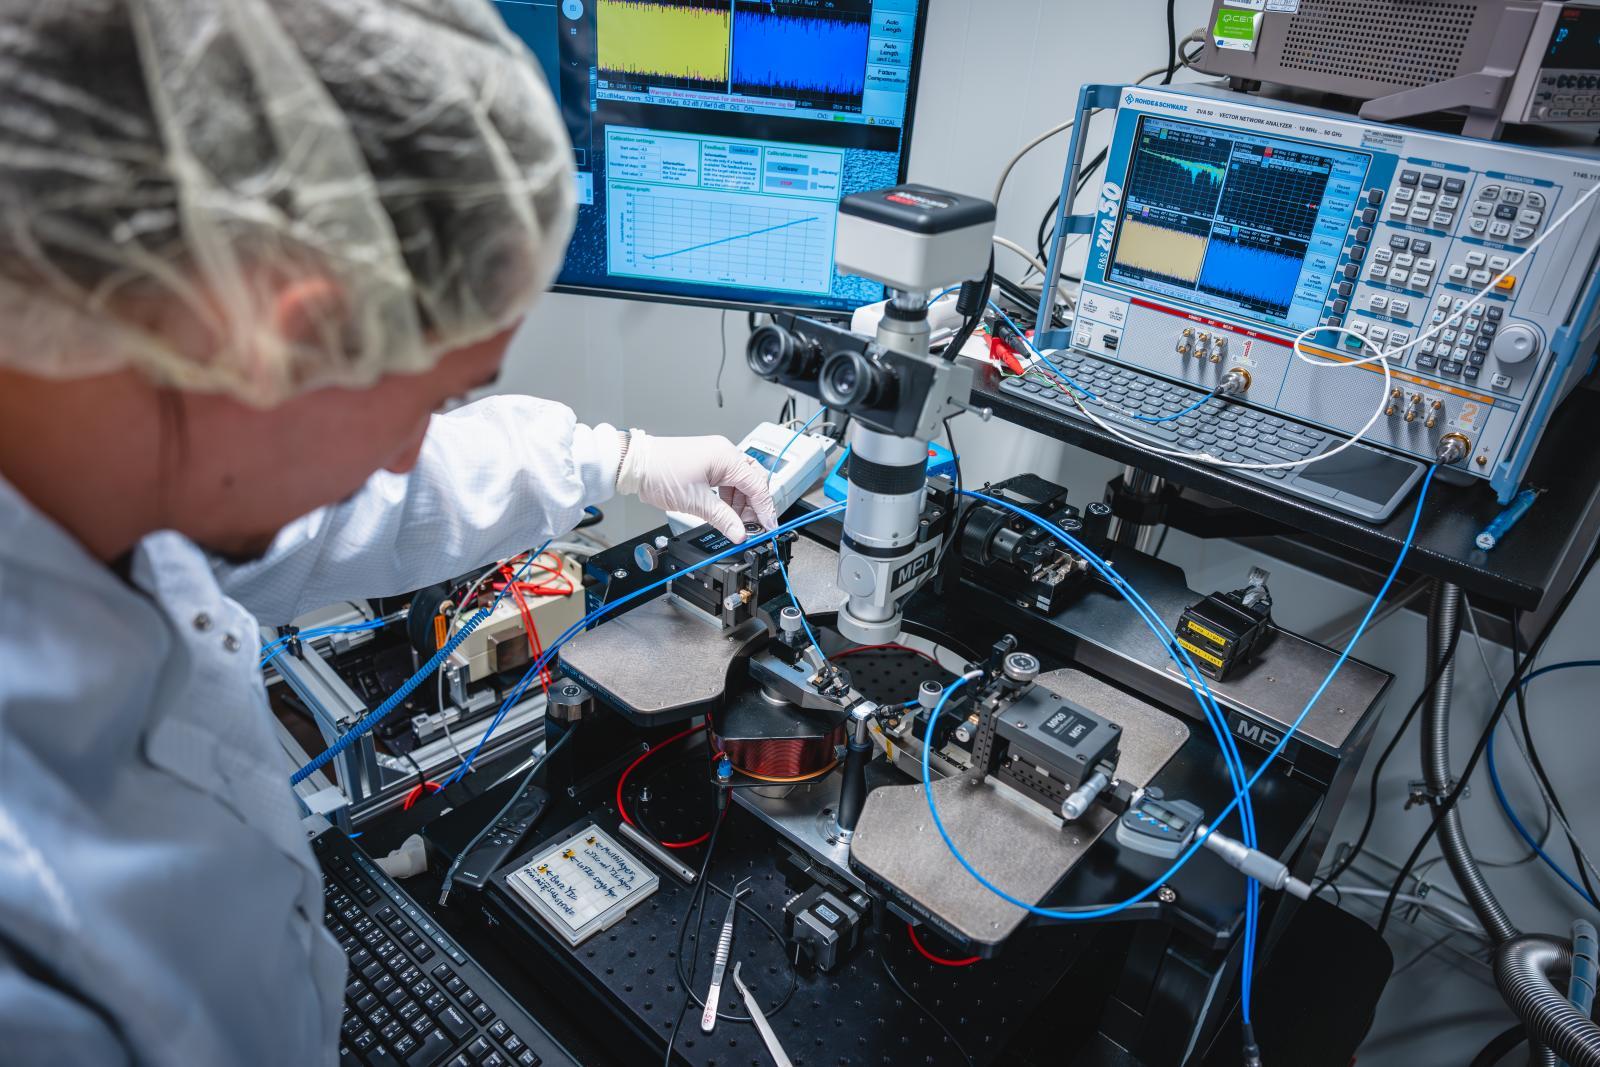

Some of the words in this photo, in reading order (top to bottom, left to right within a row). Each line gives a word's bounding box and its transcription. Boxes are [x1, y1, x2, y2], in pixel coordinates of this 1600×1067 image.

[1135, 97, 1188, 111] ROHDE&SCHWARZ
[1239, 115, 1264, 125] NETWORK
[1265, 120, 1292, 129] ANALYZER
[1099, 182, 1122, 218] 50
[1097, 219, 1115, 251] ZVA
[1483, 241, 1504, 249] SUPPORT
[1097, 252, 1108, 270] R&S
[1242, 340, 1252, 358] 1
[1460, 402, 1479, 423] 2
[898, 553, 929, 585] MPI
[1046, 712, 1067, 729] MP60
[1068, 723, 1087, 739] MPI
[551, 873, 565, 890] Bare
[447, 1007, 464, 1024] Backspace
